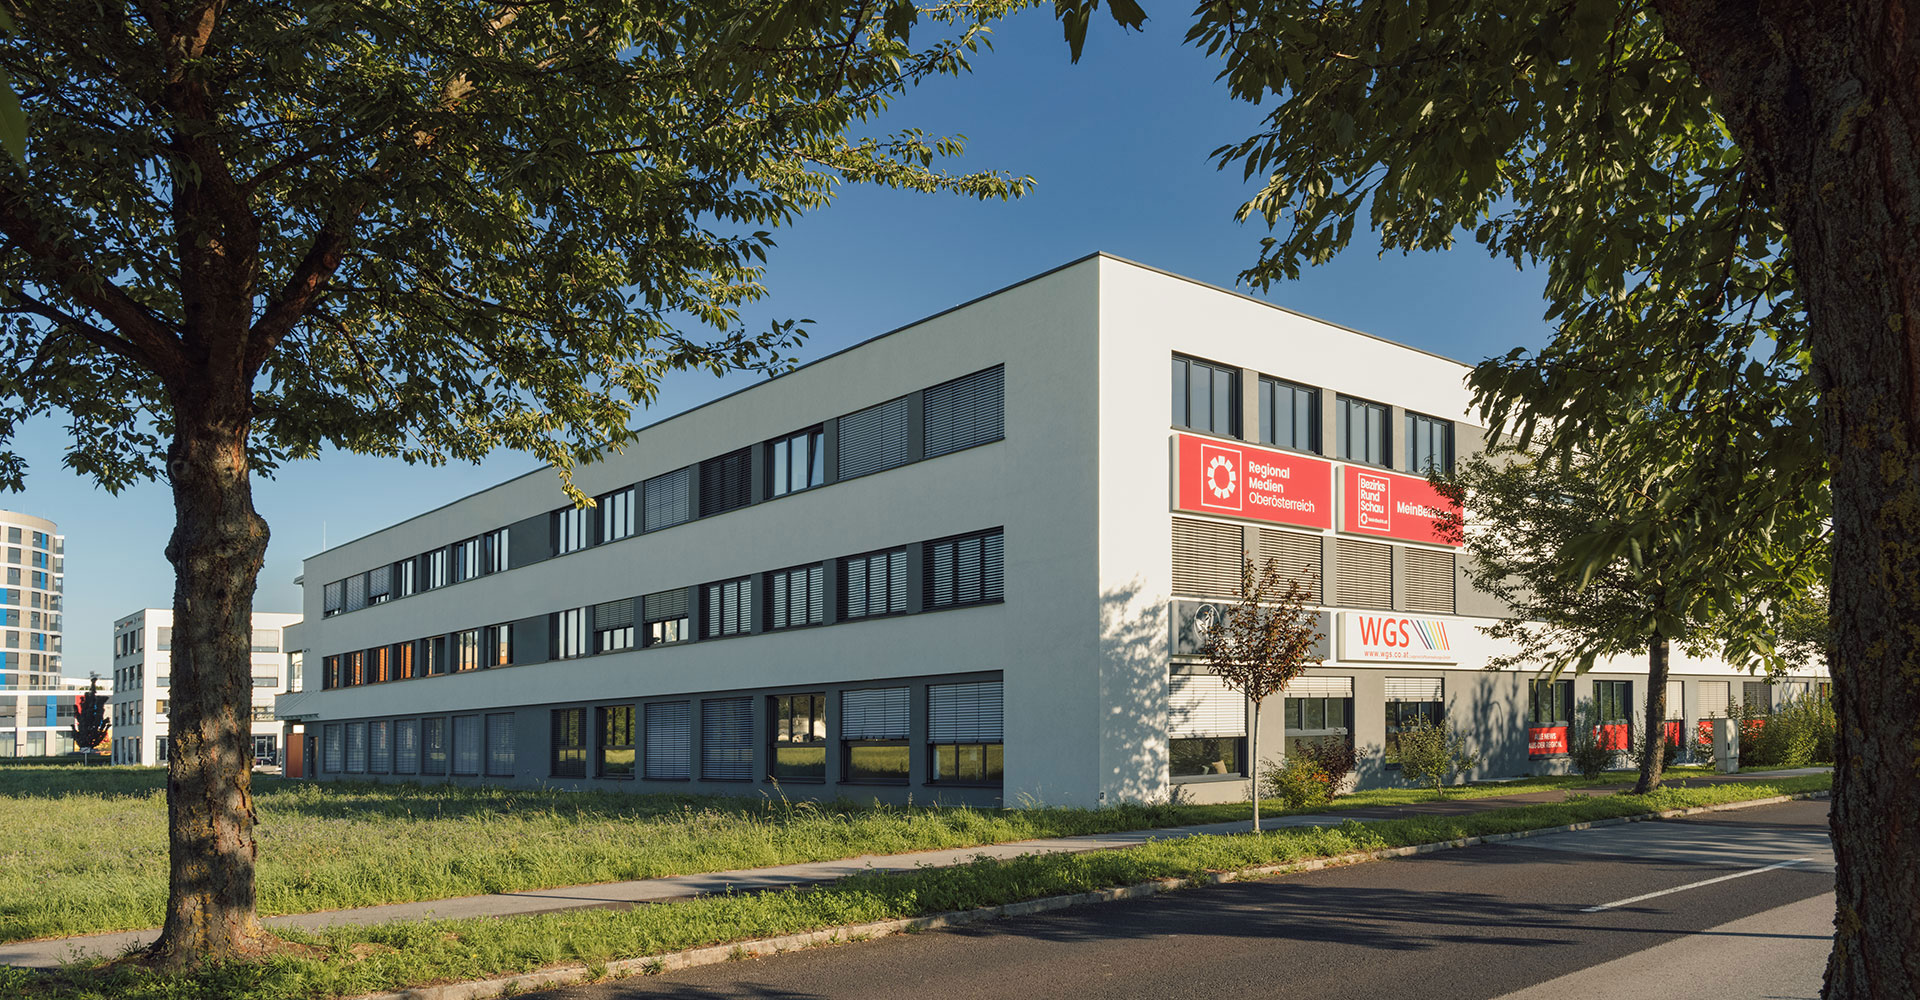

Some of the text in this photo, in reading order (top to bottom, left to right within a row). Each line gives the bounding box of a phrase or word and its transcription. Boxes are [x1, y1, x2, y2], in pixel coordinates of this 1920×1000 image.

[1249, 461, 1290, 479] Regional
[1249, 477, 1284, 493] Medien
[1361, 478, 1386, 492] Bezirks
[1249, 492, 1315, 513] Oberösterreich
[1361, 489, 1380, 502] Rund
[1361, 500, 1384, 514] Schau
[1359, 616, 1410, 648] WGS
[1544, 732, 1556, 740] NEWS
